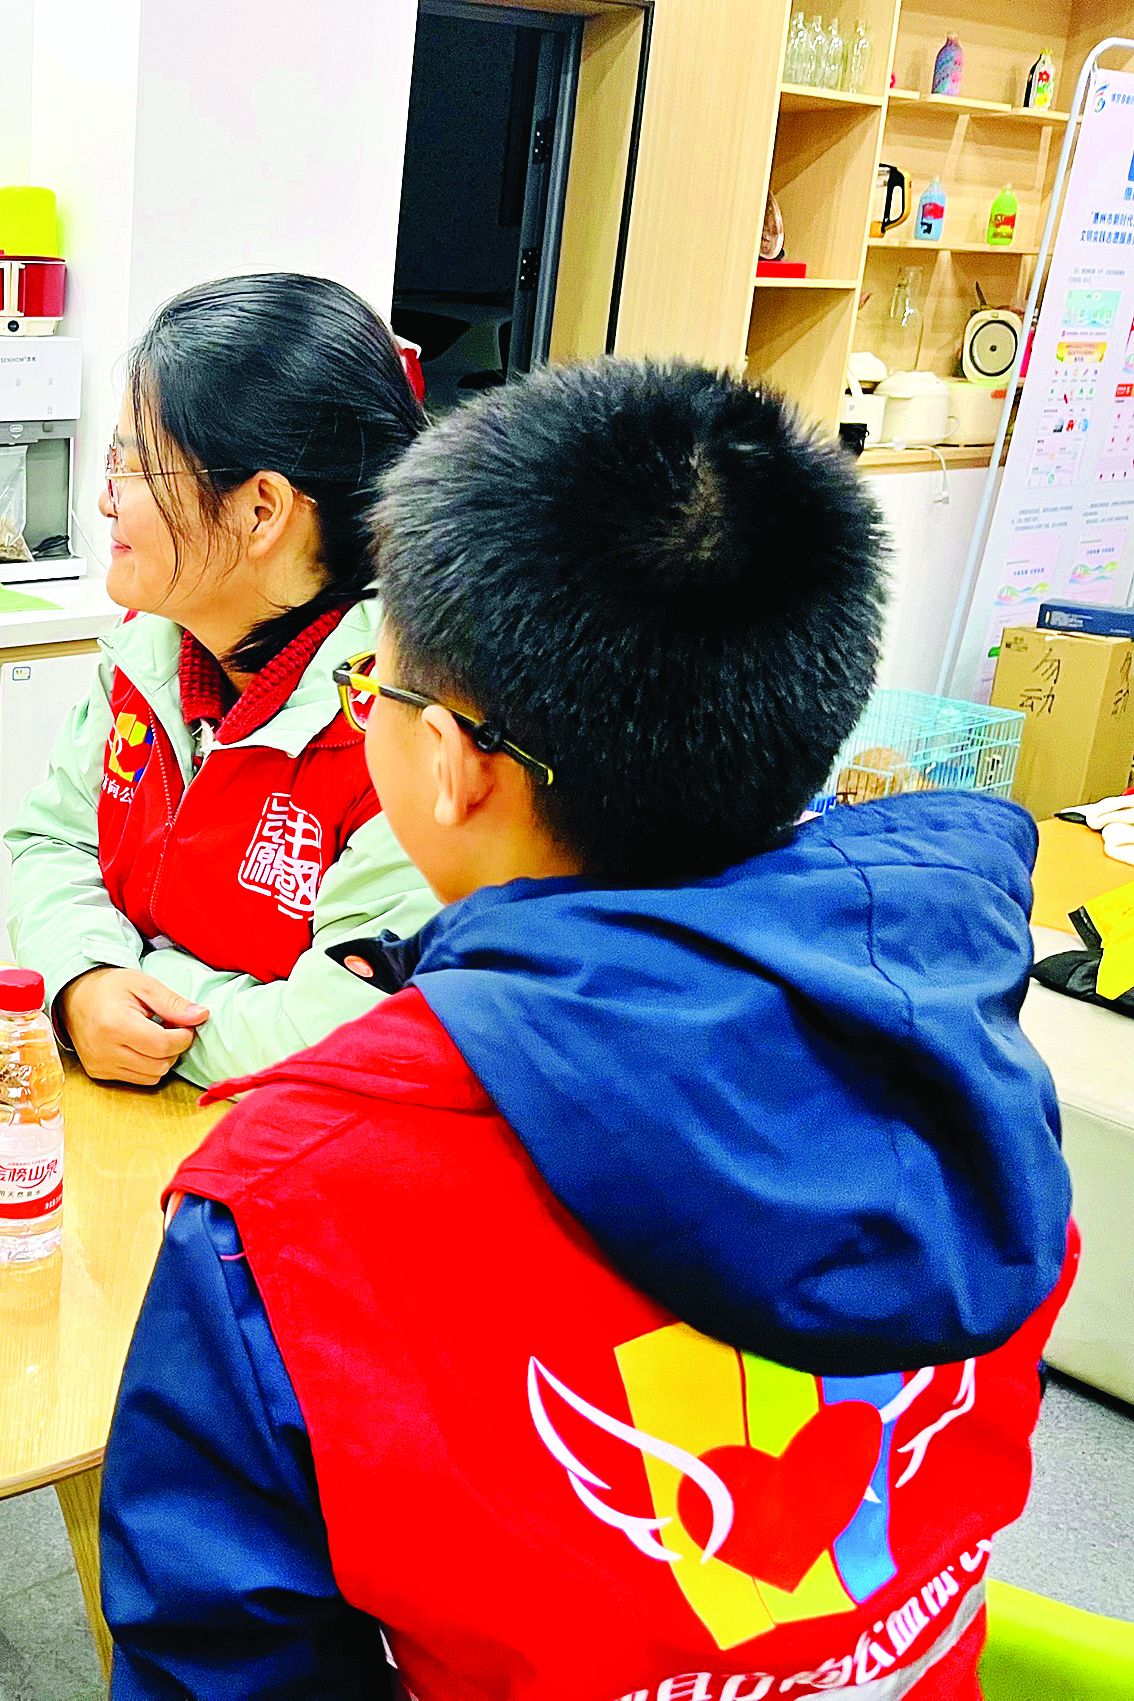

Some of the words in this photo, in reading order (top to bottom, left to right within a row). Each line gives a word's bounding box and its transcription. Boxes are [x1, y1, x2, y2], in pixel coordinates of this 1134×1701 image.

[1079, 229, 1134, 245] 文明实践志愿服务
